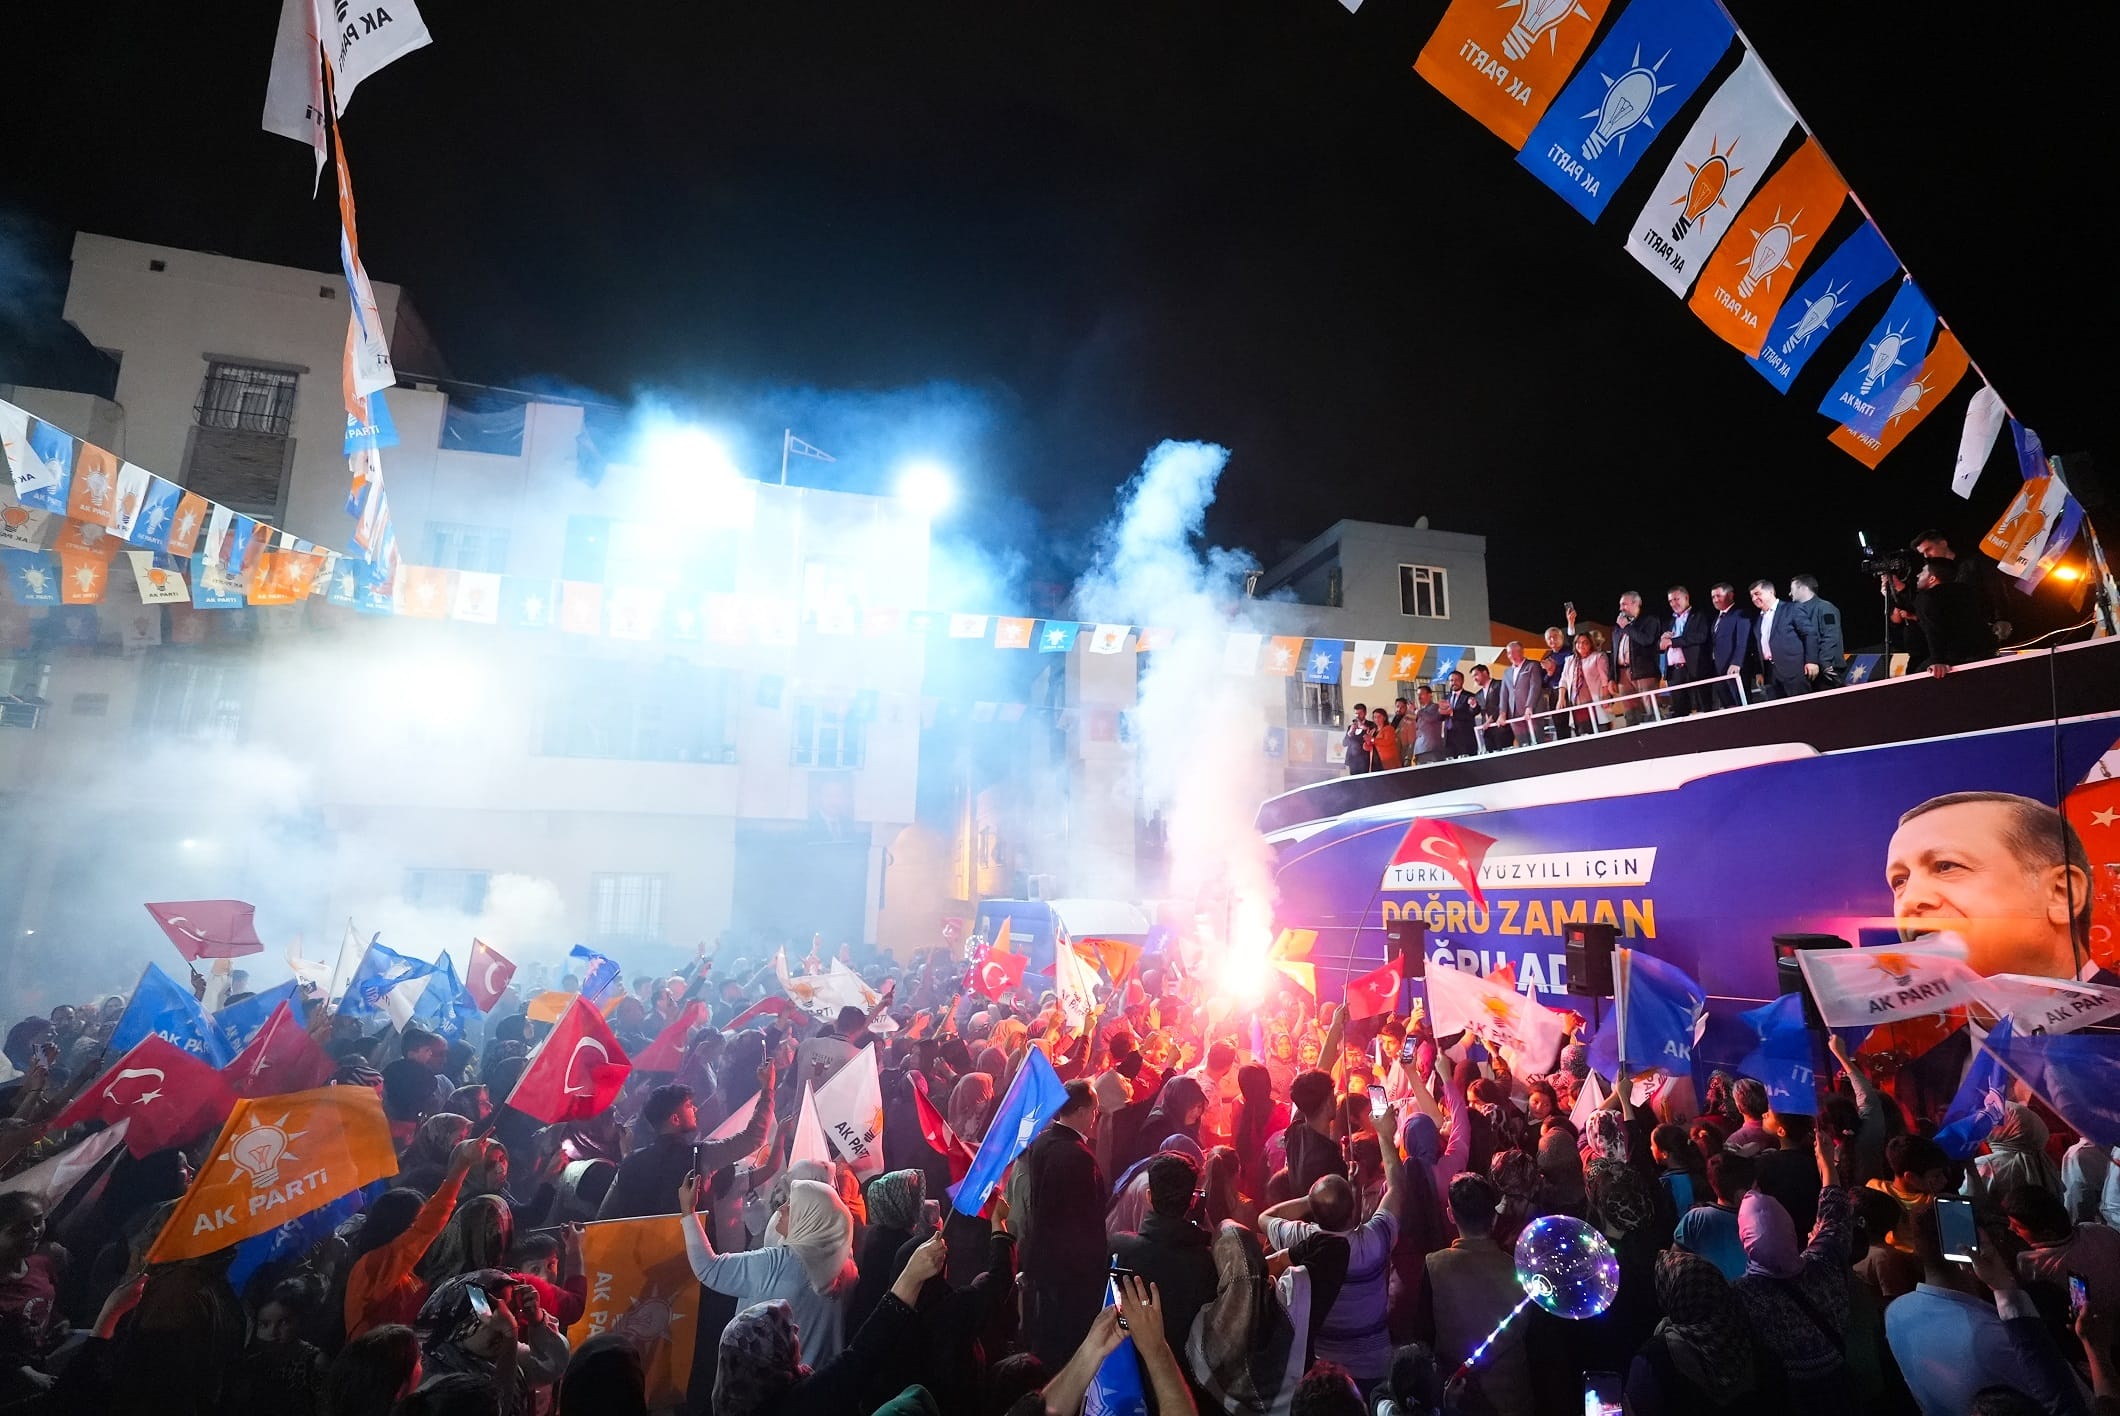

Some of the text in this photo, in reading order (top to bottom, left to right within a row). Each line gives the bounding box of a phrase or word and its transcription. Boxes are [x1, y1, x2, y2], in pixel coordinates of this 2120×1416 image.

[1839, 391, 1857, 405] AK
[1498, 898, 1657, 939] ZAMAN
[1868, 992, 1897, 1014] AK
[2046, 1006, 2074, 1025] AK
[1663, 1039, 1691, 1061] AK
[835, 1121, 854, 1141] AK
[192, 1205, 237, 1236] AK
[592, 1271, 613, 1303] AK
